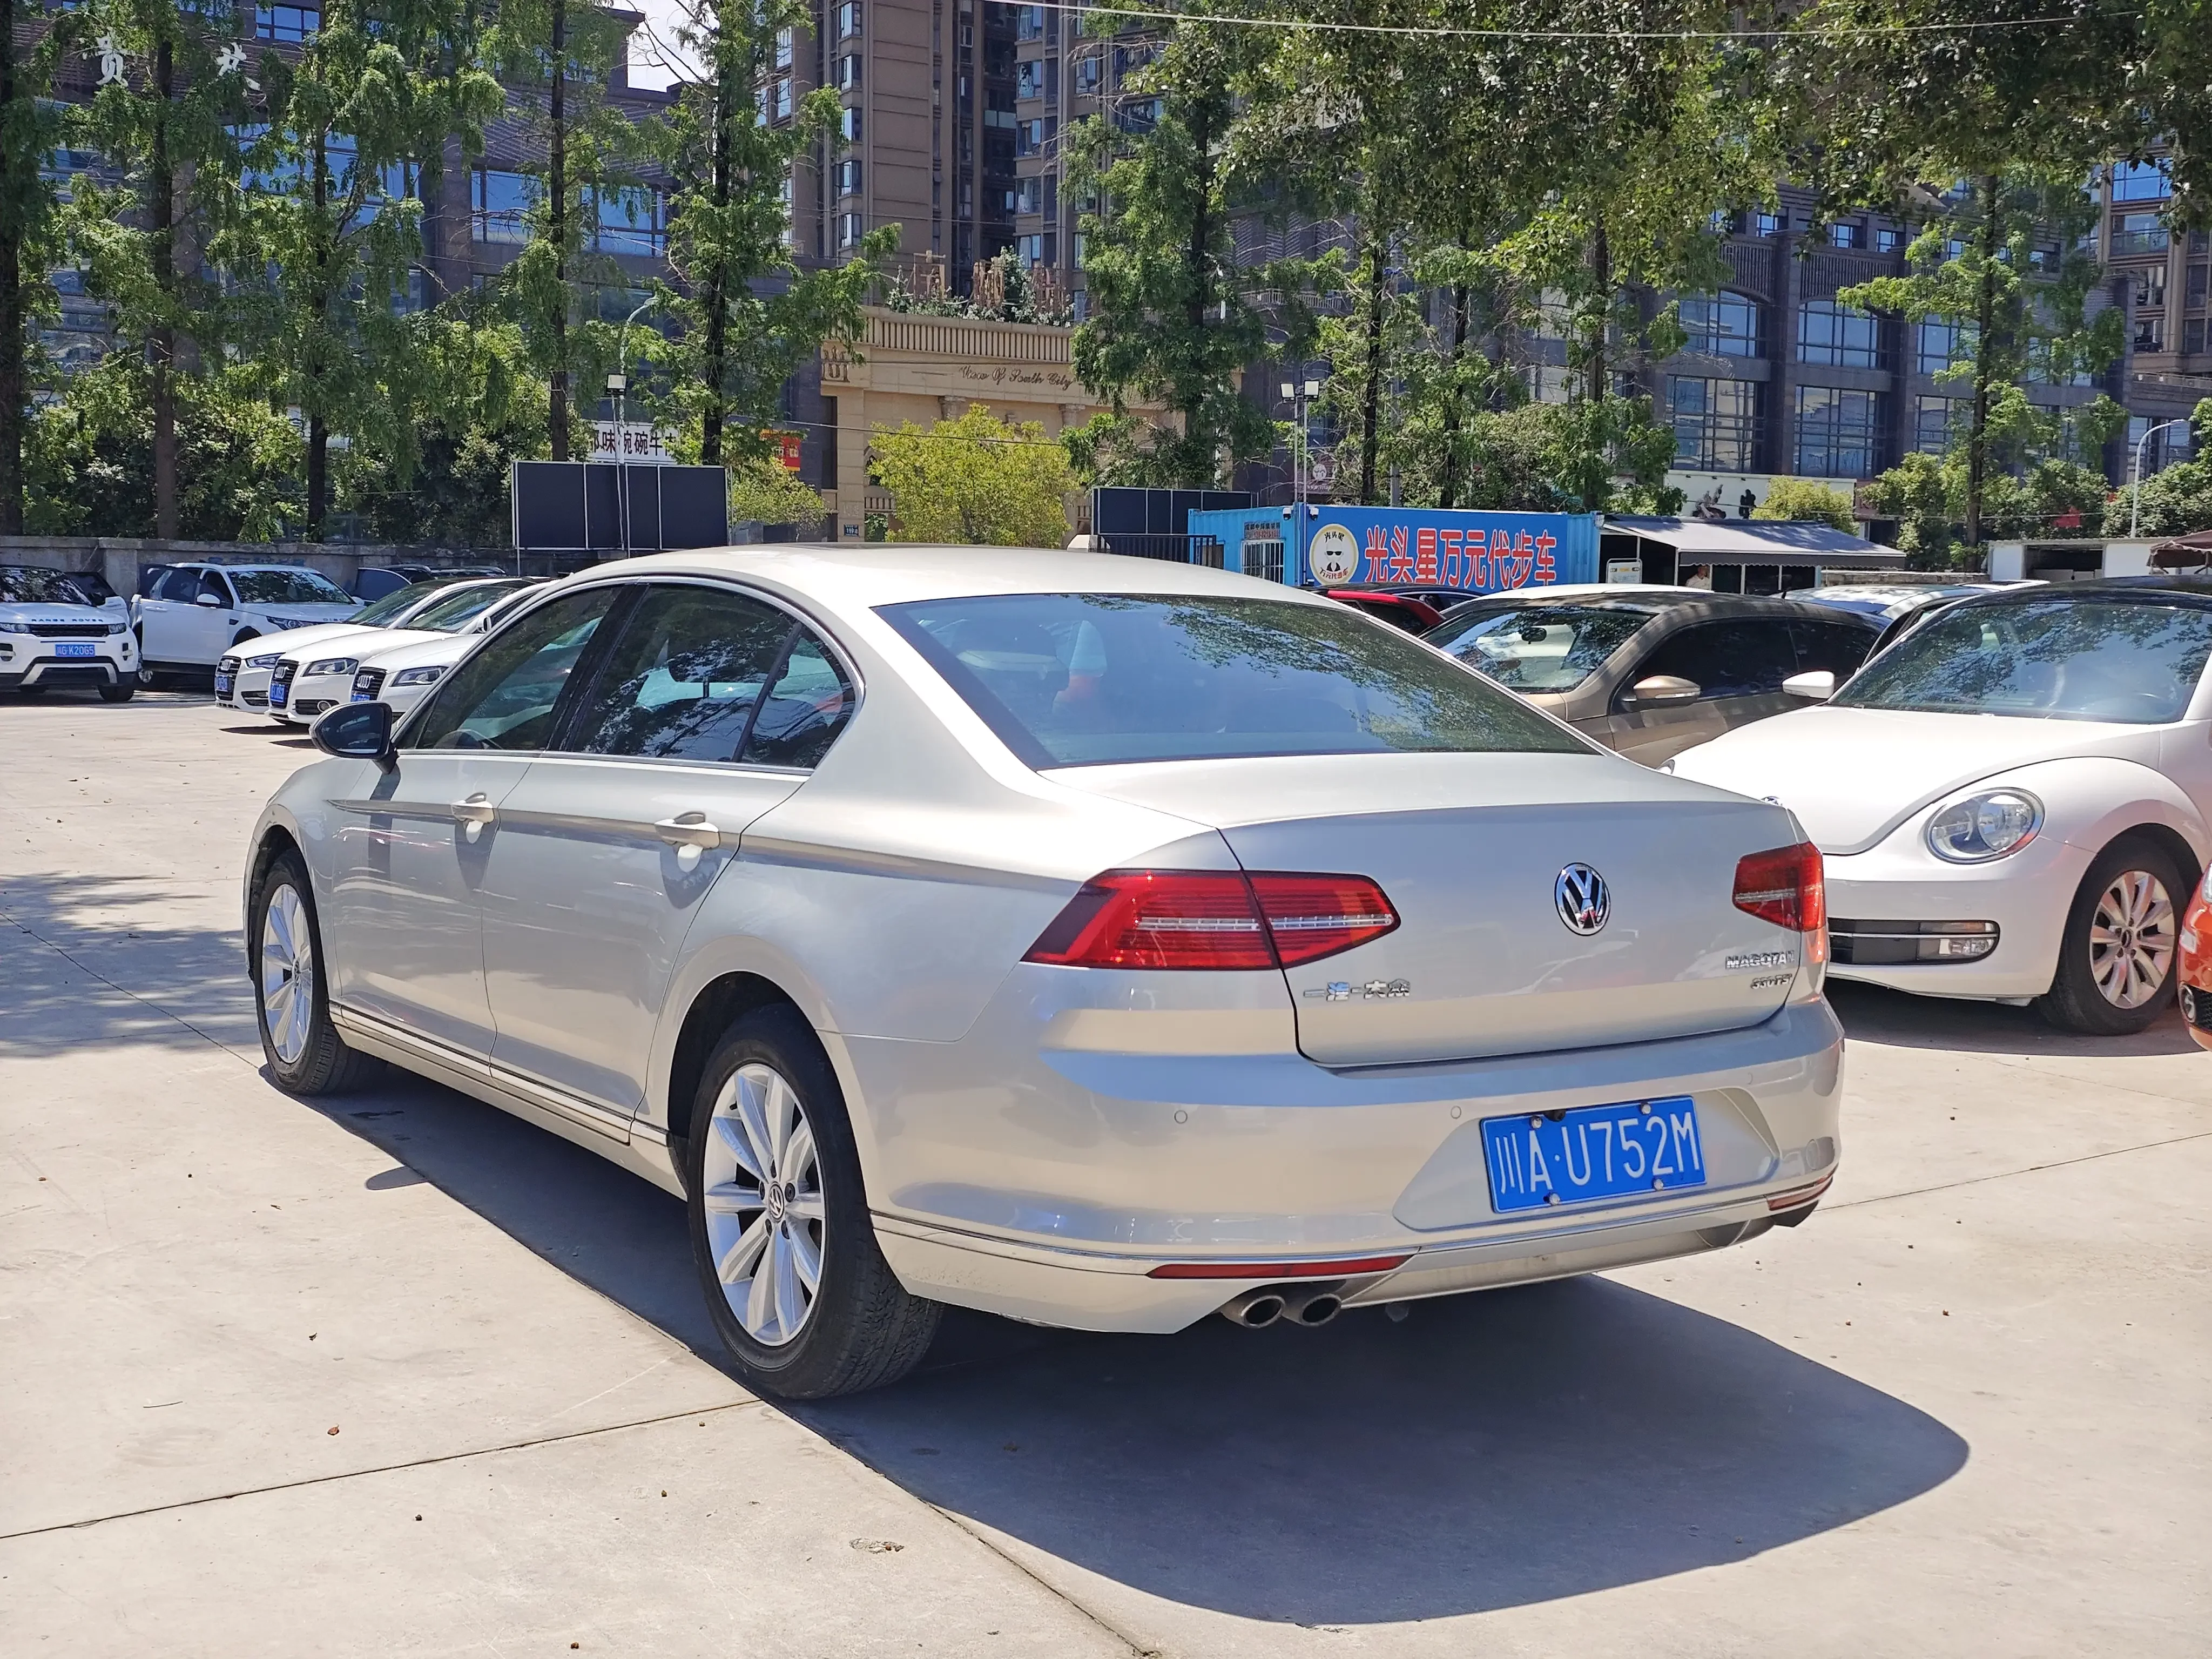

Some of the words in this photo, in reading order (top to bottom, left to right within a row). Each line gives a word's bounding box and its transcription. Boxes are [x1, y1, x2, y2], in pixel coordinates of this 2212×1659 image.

[960, 365, 989, 380] View
[992, 367, 1007, 385] Of
[1009, 369, 1044, 384] South
[1047, 372, 1075, 391] City
[1324, 531, 1345, 543] 光头星
[1365, 524, 1557, 589] 光头星万元代步车
[1725, 950, 1795, 969] MAGOTAN
